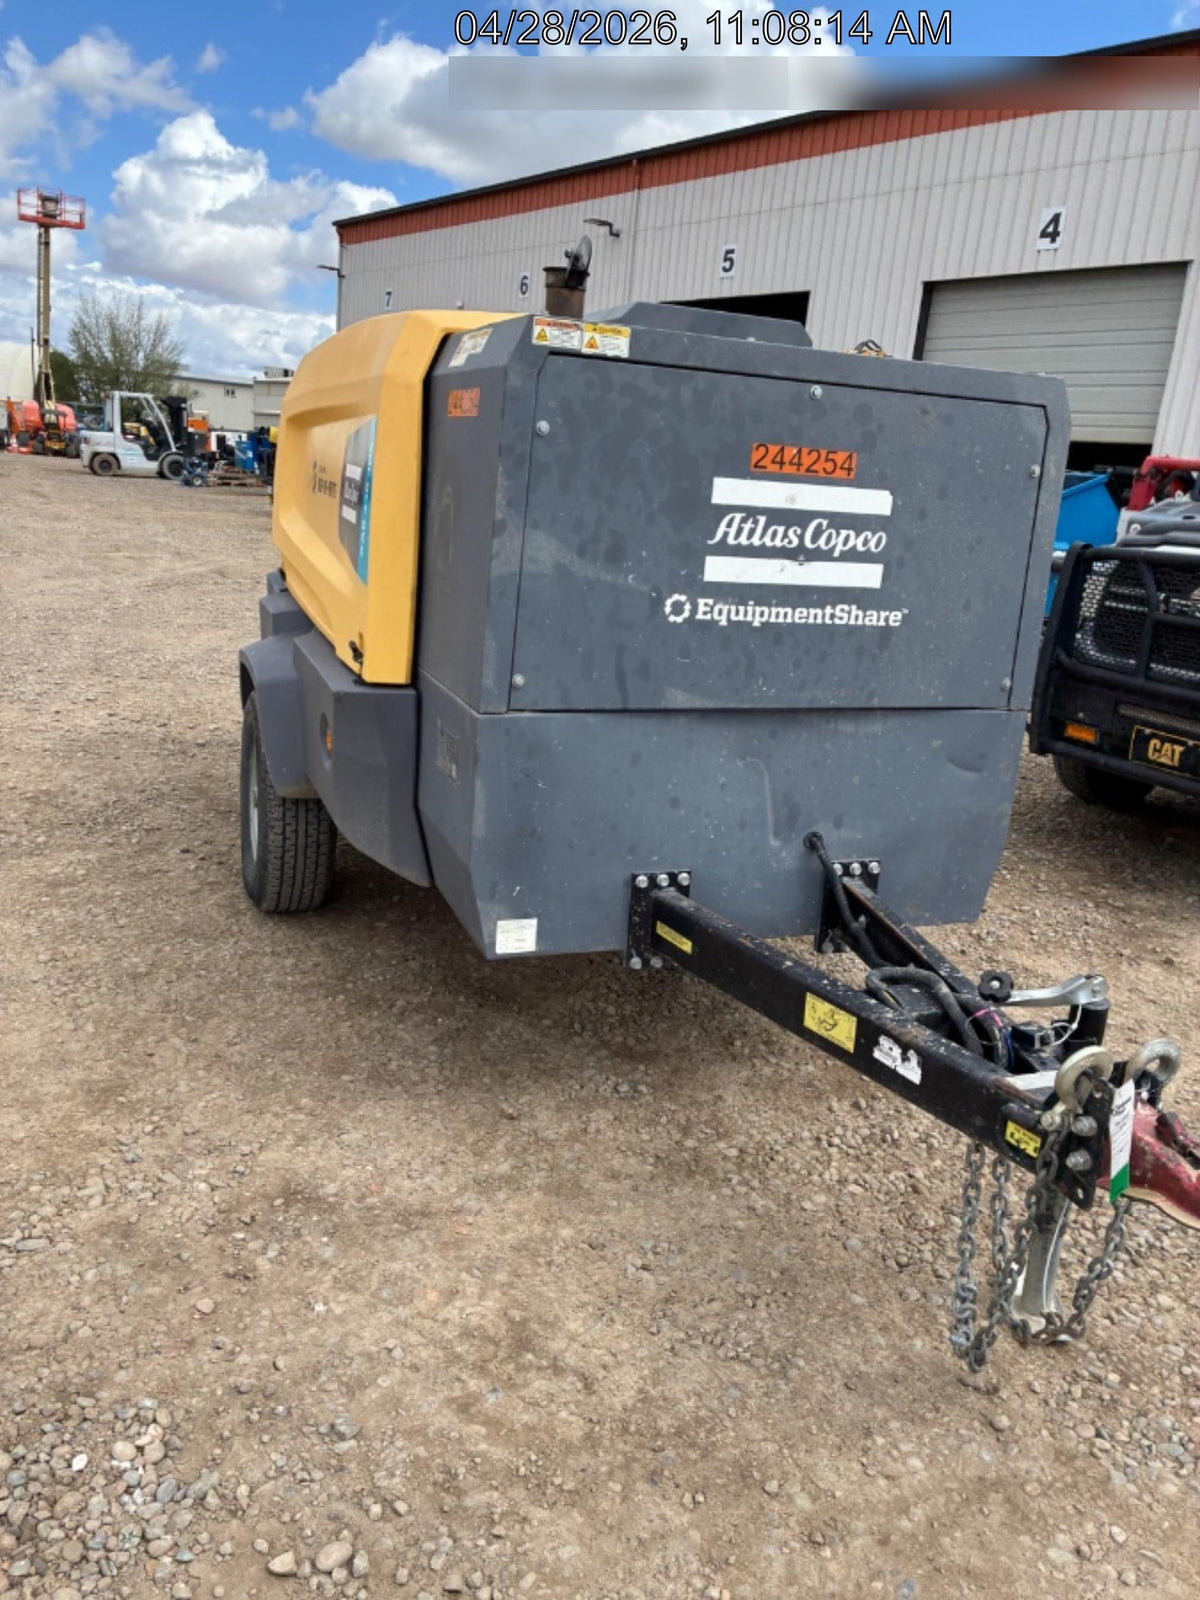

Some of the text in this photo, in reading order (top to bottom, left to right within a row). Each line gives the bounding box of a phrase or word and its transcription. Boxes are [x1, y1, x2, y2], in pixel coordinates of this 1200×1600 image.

[1038, 212, 1062, 243] 4
[721, 250, 735, 272] 5
[384, 291, 393, 306] 7
[519, 275, 529, 295] 6
[752, 443, 856, 477] 244254
[708, 513, 887, 557] Atlas Copco
[1147, 738, 1186, 767] CAT
